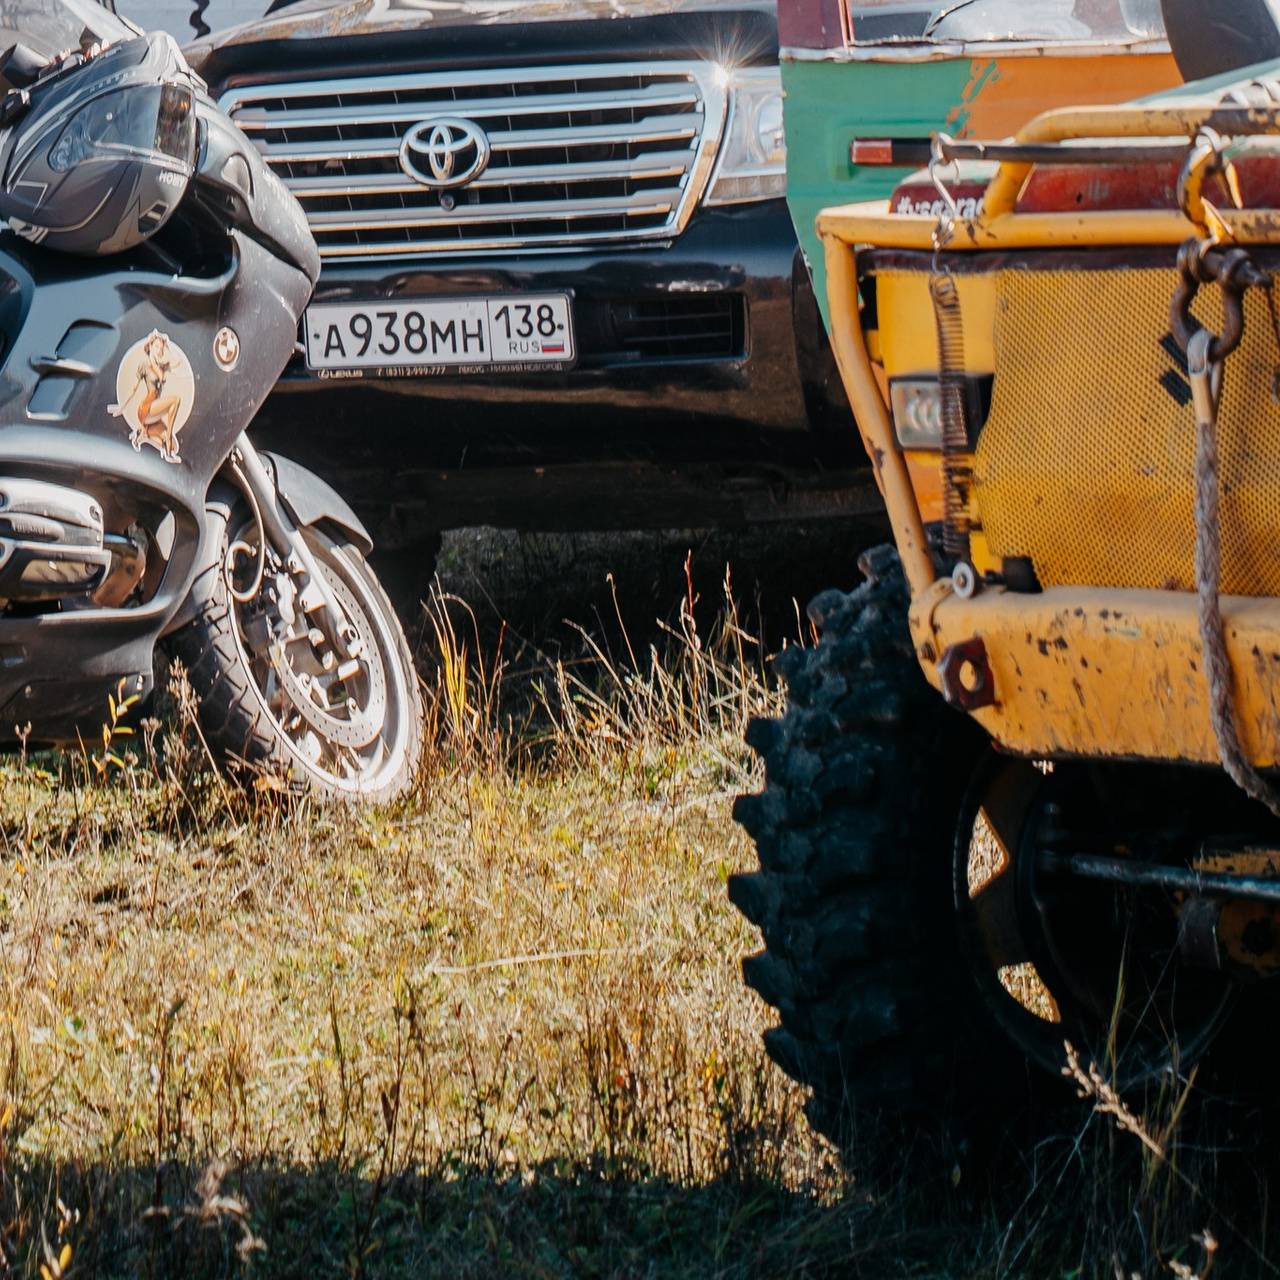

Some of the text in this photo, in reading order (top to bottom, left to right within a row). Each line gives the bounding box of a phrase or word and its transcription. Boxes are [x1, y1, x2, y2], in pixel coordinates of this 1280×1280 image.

[323, 304, 557, 358] А938МН 138
[509, 341, 540, 354] RUS
